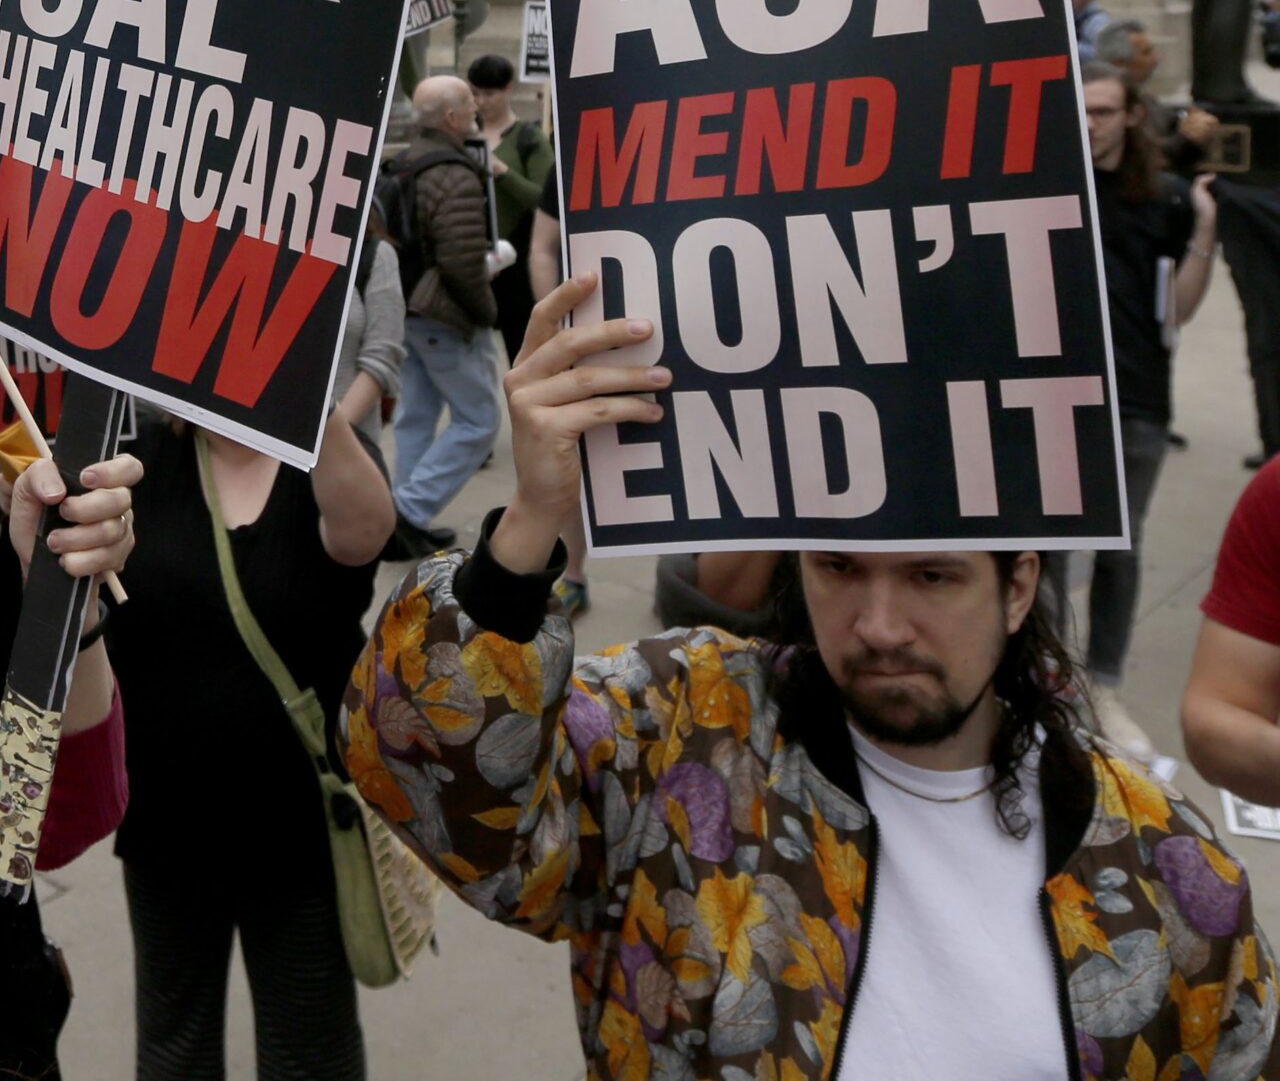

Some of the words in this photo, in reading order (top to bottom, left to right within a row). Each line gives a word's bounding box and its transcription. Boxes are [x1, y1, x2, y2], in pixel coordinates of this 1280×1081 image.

[569, 74, 898, 212] MEND
[939, 53, 1068, 180] IT
[569, 194, 1084, 375] DON'T
[583, 384, 888, 528] END
[945, 374, 1106, 519] IT
